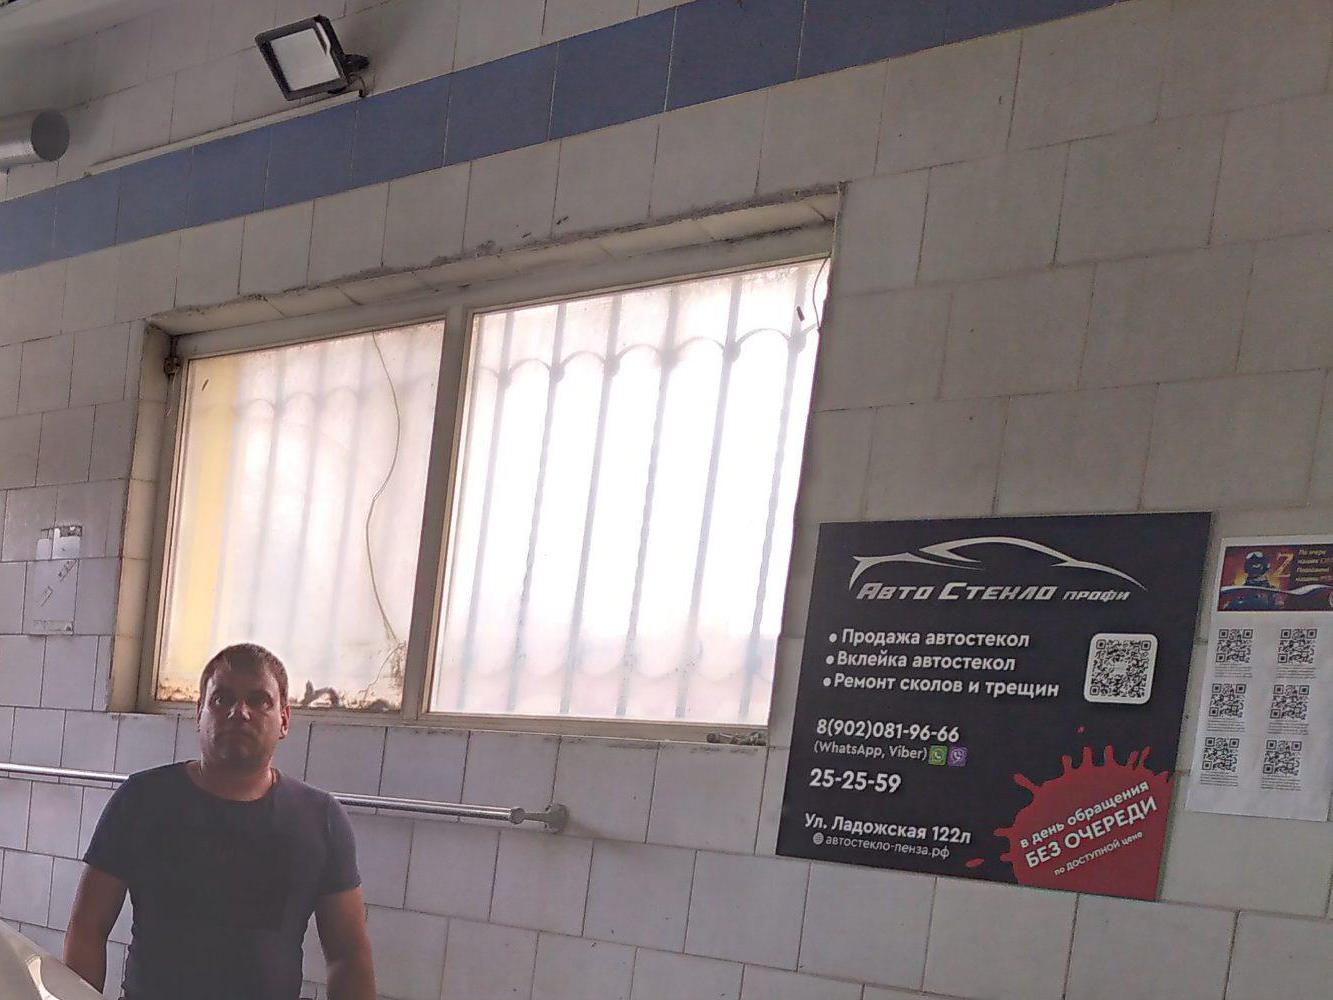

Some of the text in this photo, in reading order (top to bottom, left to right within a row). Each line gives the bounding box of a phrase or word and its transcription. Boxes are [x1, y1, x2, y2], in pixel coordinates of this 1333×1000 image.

[841, 628, 1031, 648] Продажа автостекол
[836, 649, 1017, 672] Вклейка автостекол
[833, 672, 1061, 699] Ремонт сколов и трещин
[816, 718, 961, 744] 8(902)081-96-66
[813, 740, 928, 761] (WhatsApp, Viber)
[808, 767, 903, 794] 25-25-59
[1020, 781, 1150, 848] в день обращения
[804, 812, 972, 845] Ул. Ладожская 122л
[1025, 795, 1158, 868] БЕЗ ОЧЕРЕДИ
[825, 834, 951, 860] автостекло-пенза.рф
[1054, 866, 1066, 876] по
[1121, 831, 1144, 847] цене
